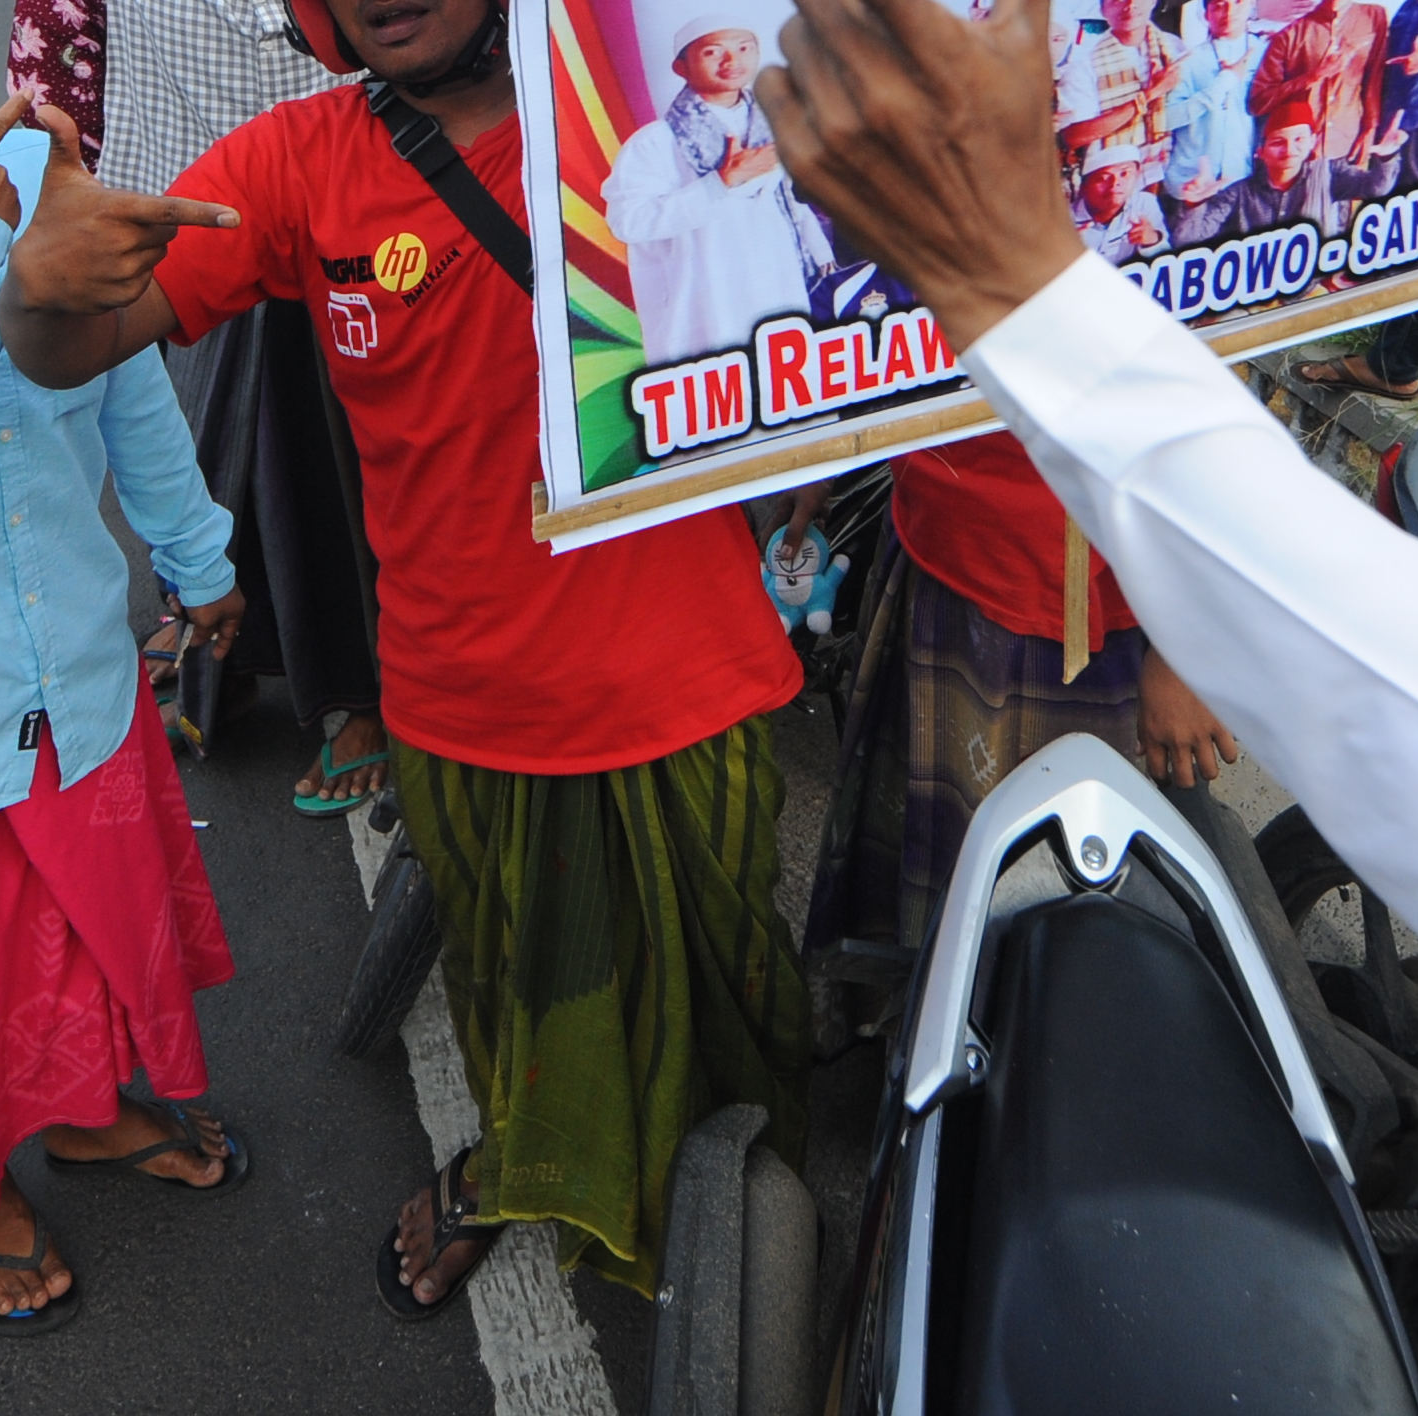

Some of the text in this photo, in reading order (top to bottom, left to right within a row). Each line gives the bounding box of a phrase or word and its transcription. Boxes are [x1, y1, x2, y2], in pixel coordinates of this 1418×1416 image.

[380, 234, 422, 293] hp
[640, 360, 747, 448] TIM
[765, 316, 959, 415] RELAW
